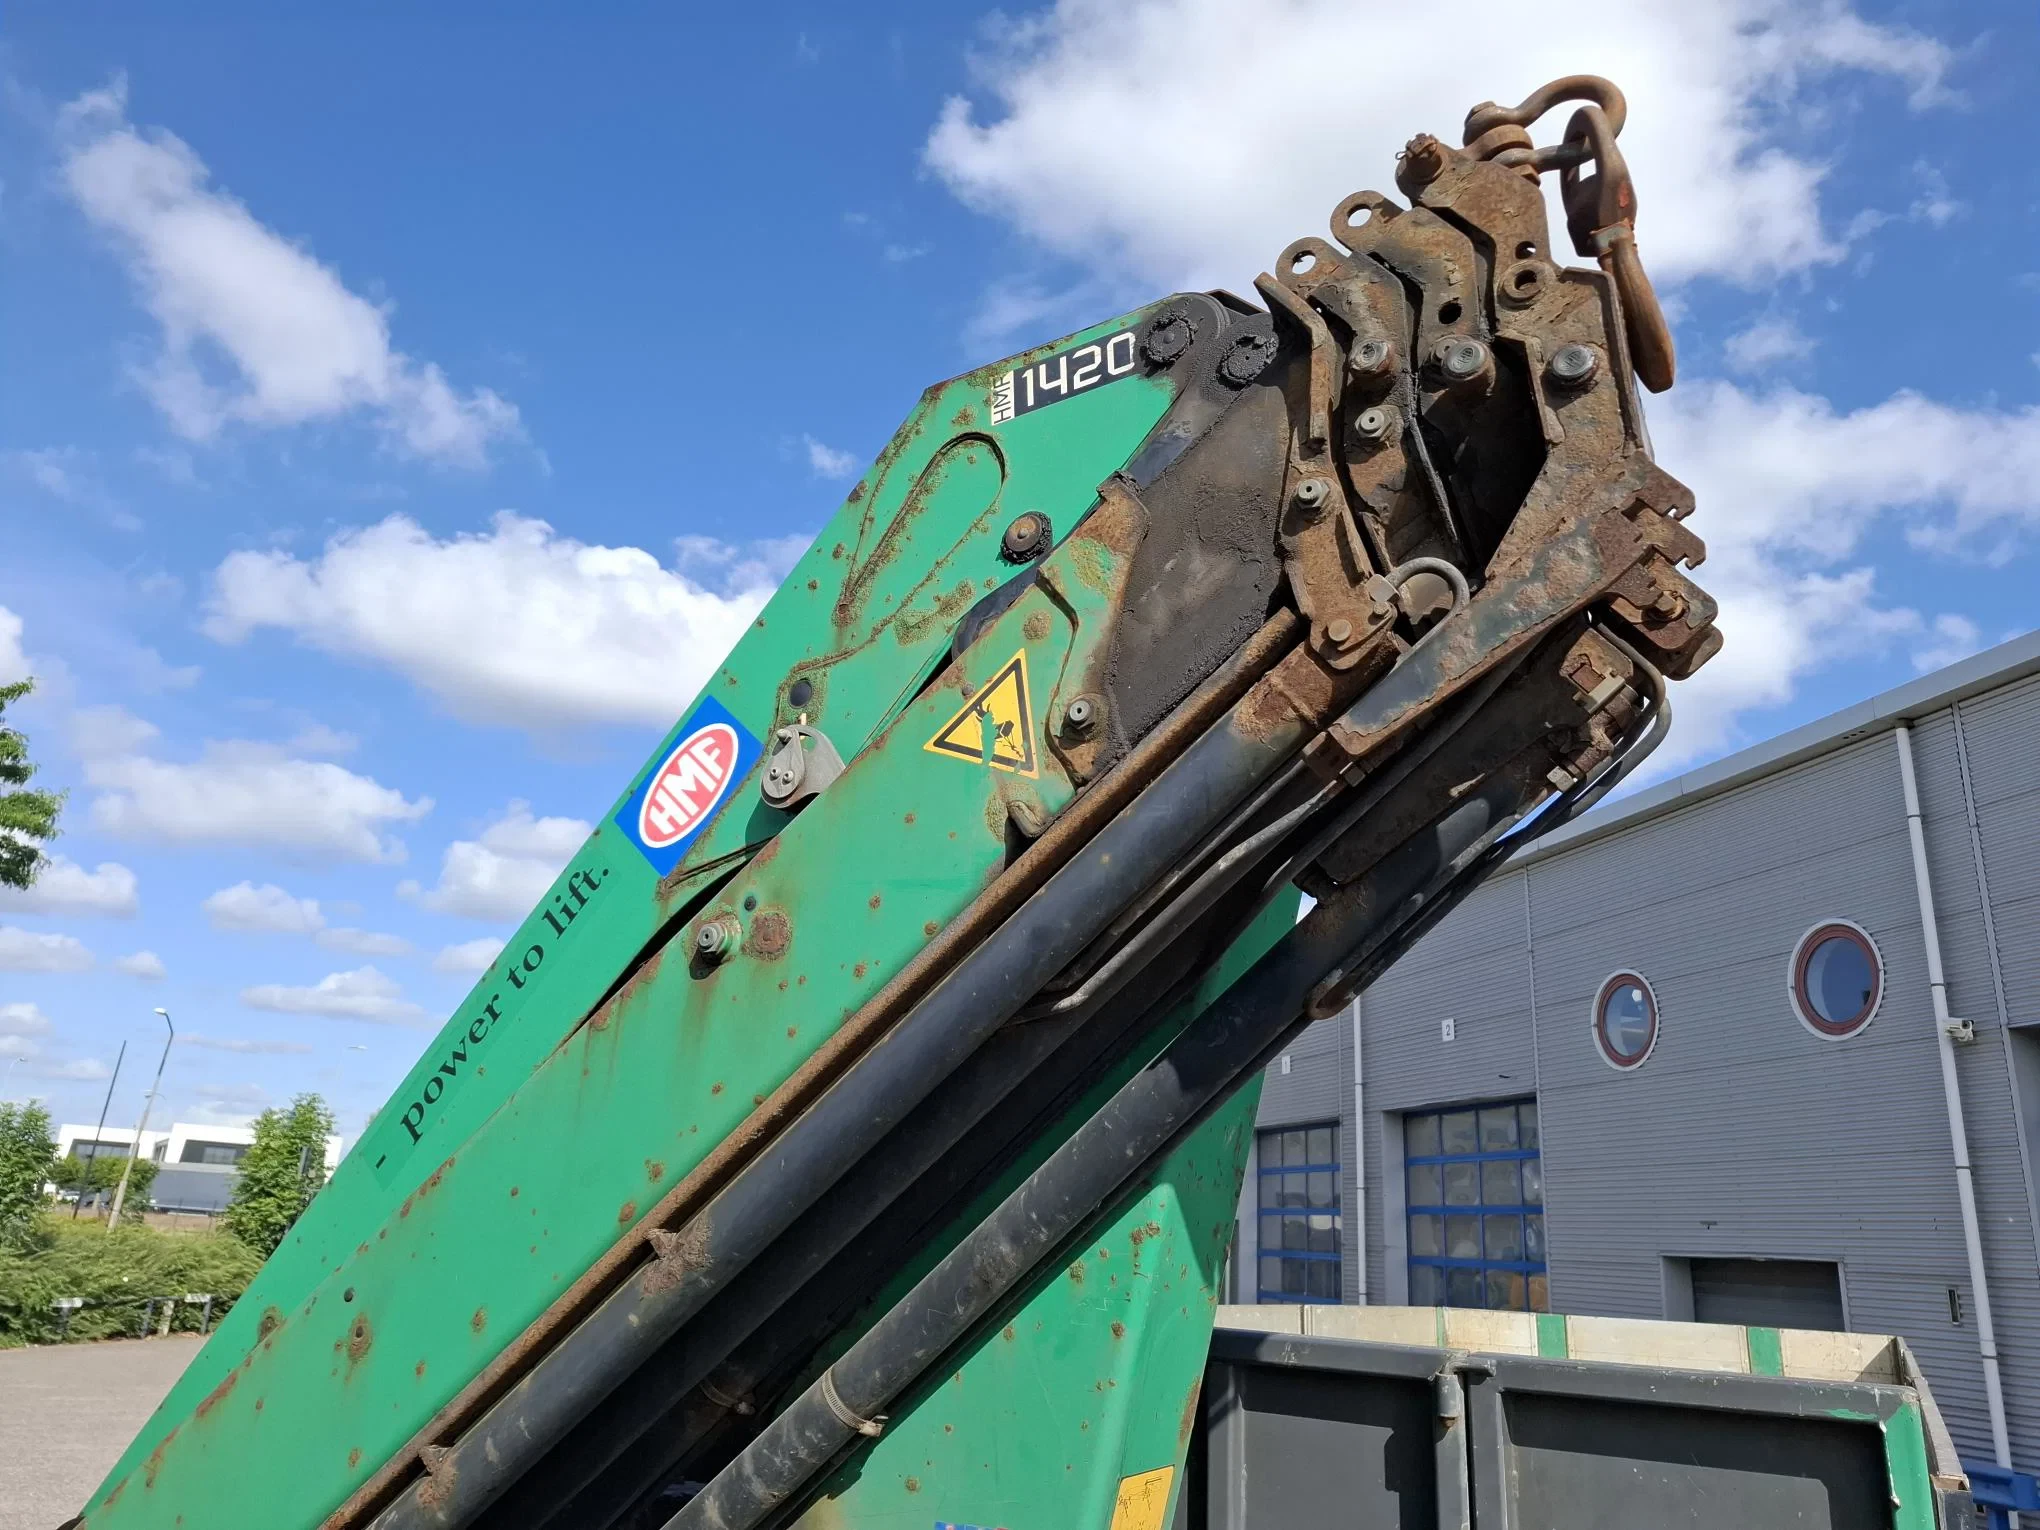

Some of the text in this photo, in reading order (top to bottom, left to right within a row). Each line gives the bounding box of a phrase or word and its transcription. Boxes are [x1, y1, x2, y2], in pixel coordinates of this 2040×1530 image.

[1022, 332, 1135, 407] 1420
[649, 737, 724, 835] HMF
[400, 993, 502, 1145] power
[506, 944, 544, 989] to
[541, 868, 609, 940] lift.
[1445, 1024, 1451, 1036] 2
